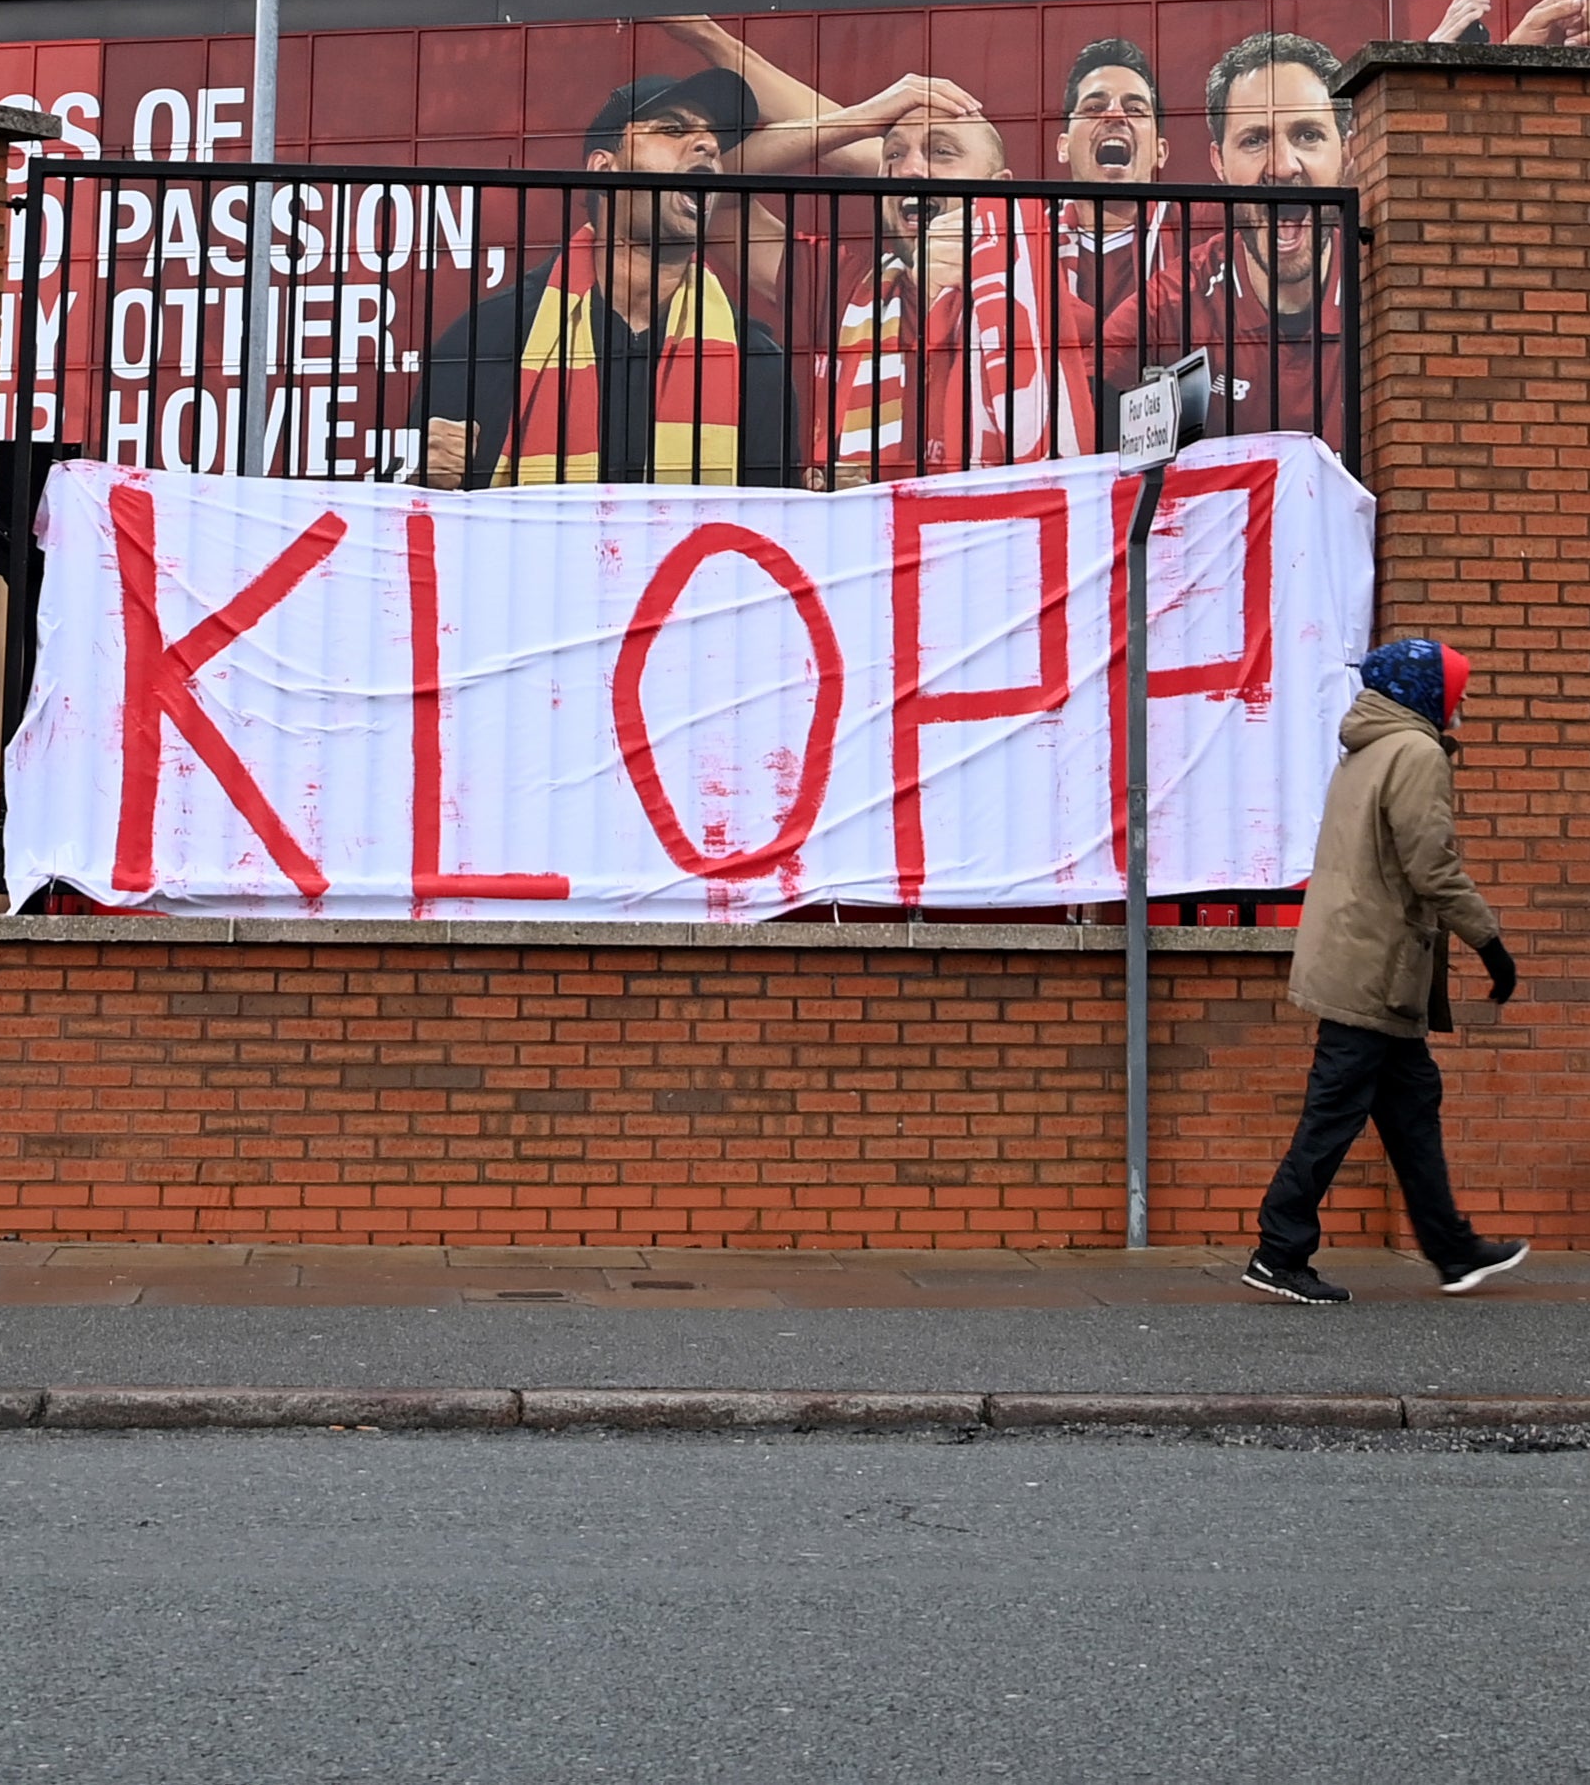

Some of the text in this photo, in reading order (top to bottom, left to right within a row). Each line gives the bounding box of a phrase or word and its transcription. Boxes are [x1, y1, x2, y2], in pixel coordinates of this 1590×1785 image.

[133, 87, 246, 163] OF
[98, 182, 506, 290] PASSION,
[111, 282, 420, 381] OTHER.
[1121, 421, 1169, 456] Primary School
[1128, 393, 1161, 423] Four Oaks
[108, 458, 1278, 905] KLOPP
